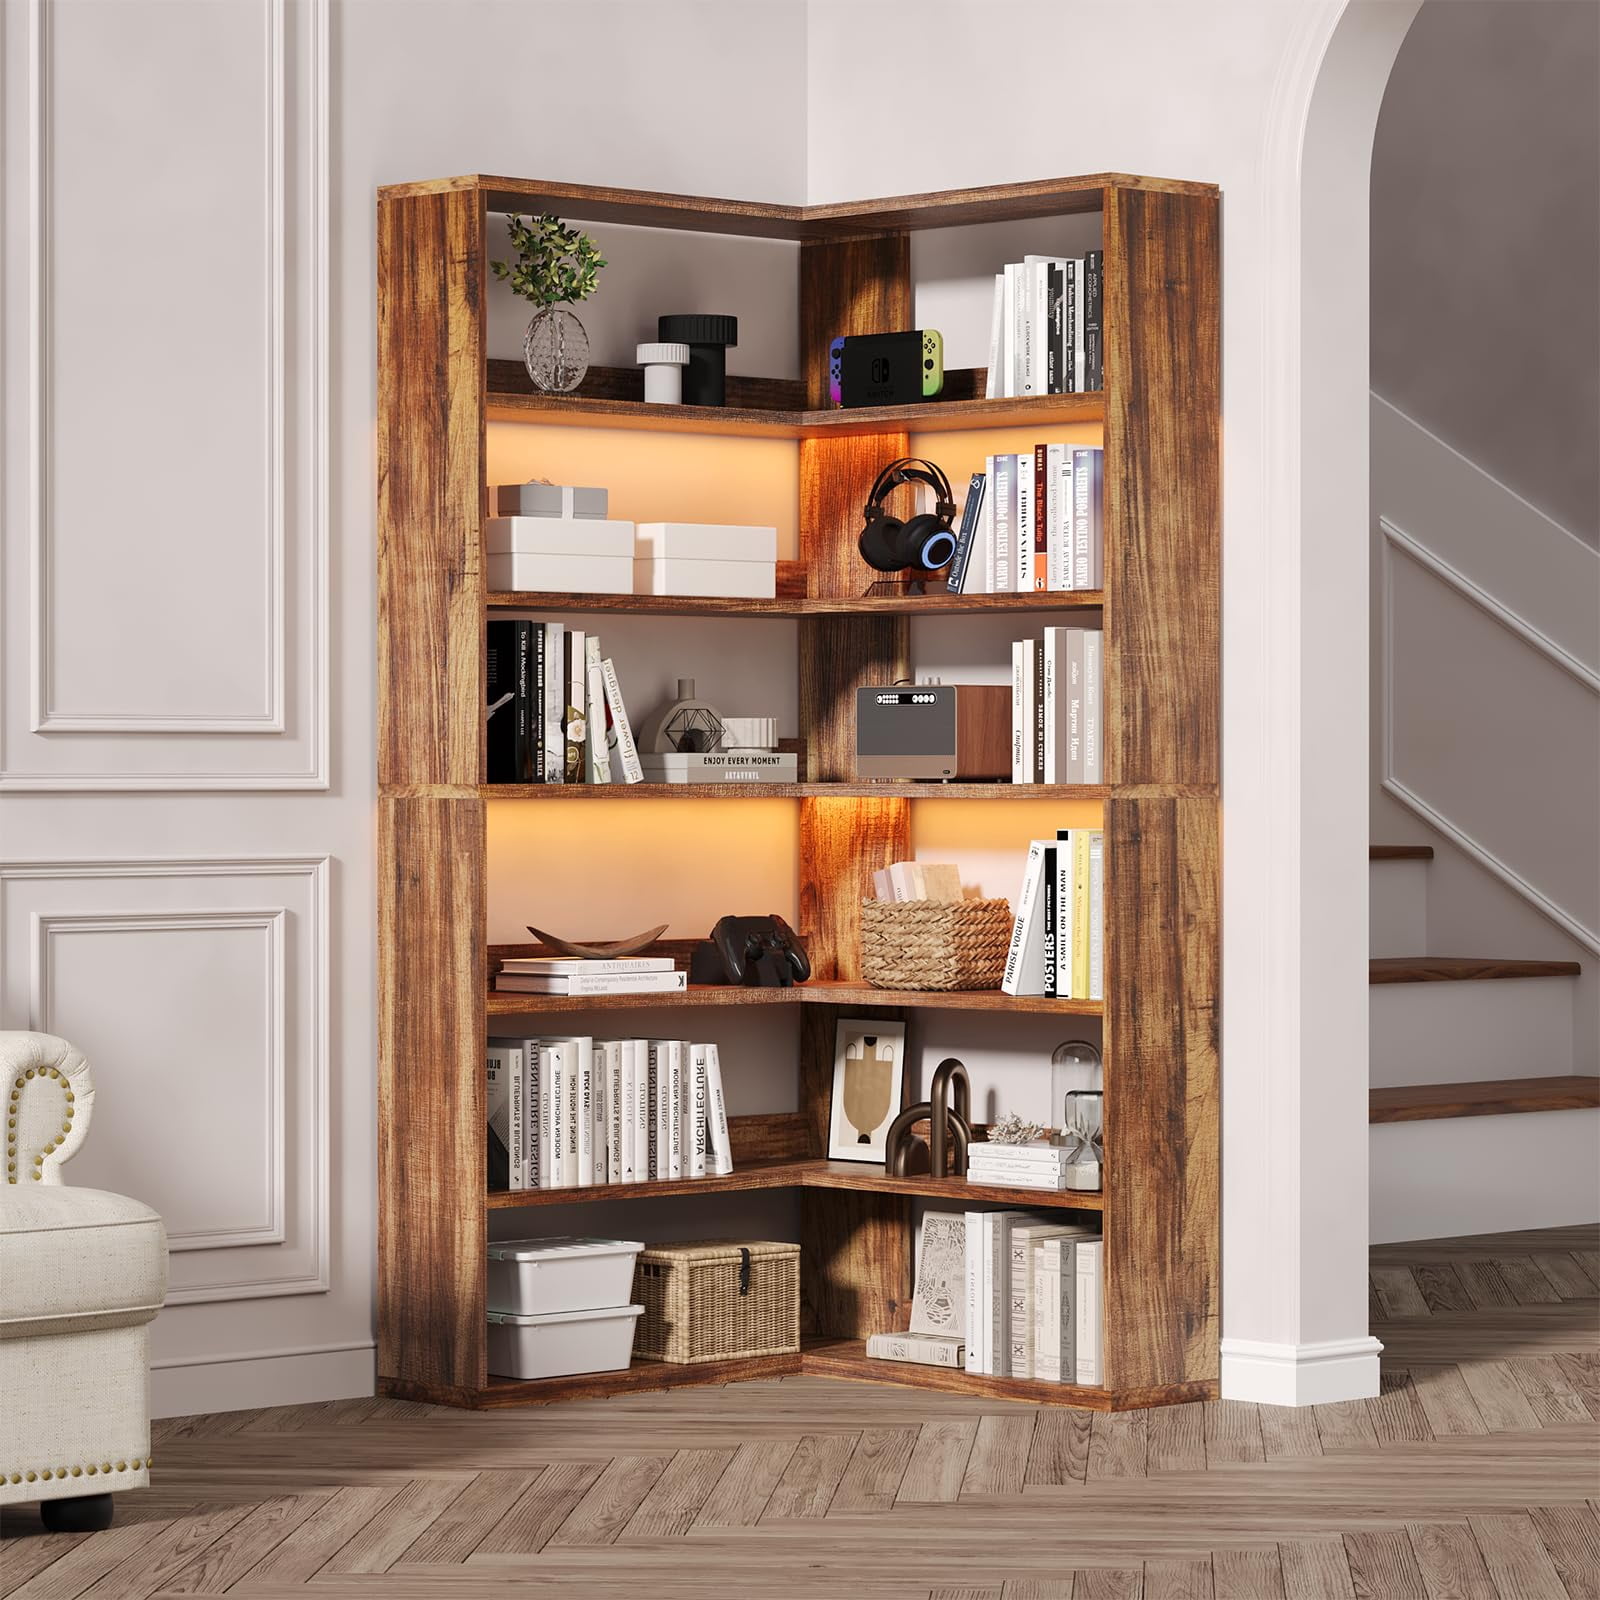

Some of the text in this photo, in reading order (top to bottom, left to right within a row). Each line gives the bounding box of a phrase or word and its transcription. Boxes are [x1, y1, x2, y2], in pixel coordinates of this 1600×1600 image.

[956, 544, 964, 554] the
[959, 532, 968, 543] Box
[997, 523, 1008, 558] TESTINO
[1076, 520, 1088, 554] TESTINO
[952, 555, 962, 577] Outside
[997, 560, 1008, 589] MARIO
[1076, 558, 1088, 586] MARIO
[521, 631, 526, 639] To
[604, 660, 634, 758] flower designer
[1069, 699, 1079, 760] Мартин Иден
[1014, 730, 1022, 765] Спартак
[1060, 915, 1066, 930] ON
[1005, 915, 1025, 984] PARISE VOGUE
[1044, 933, 1054, 992] POSTERS
